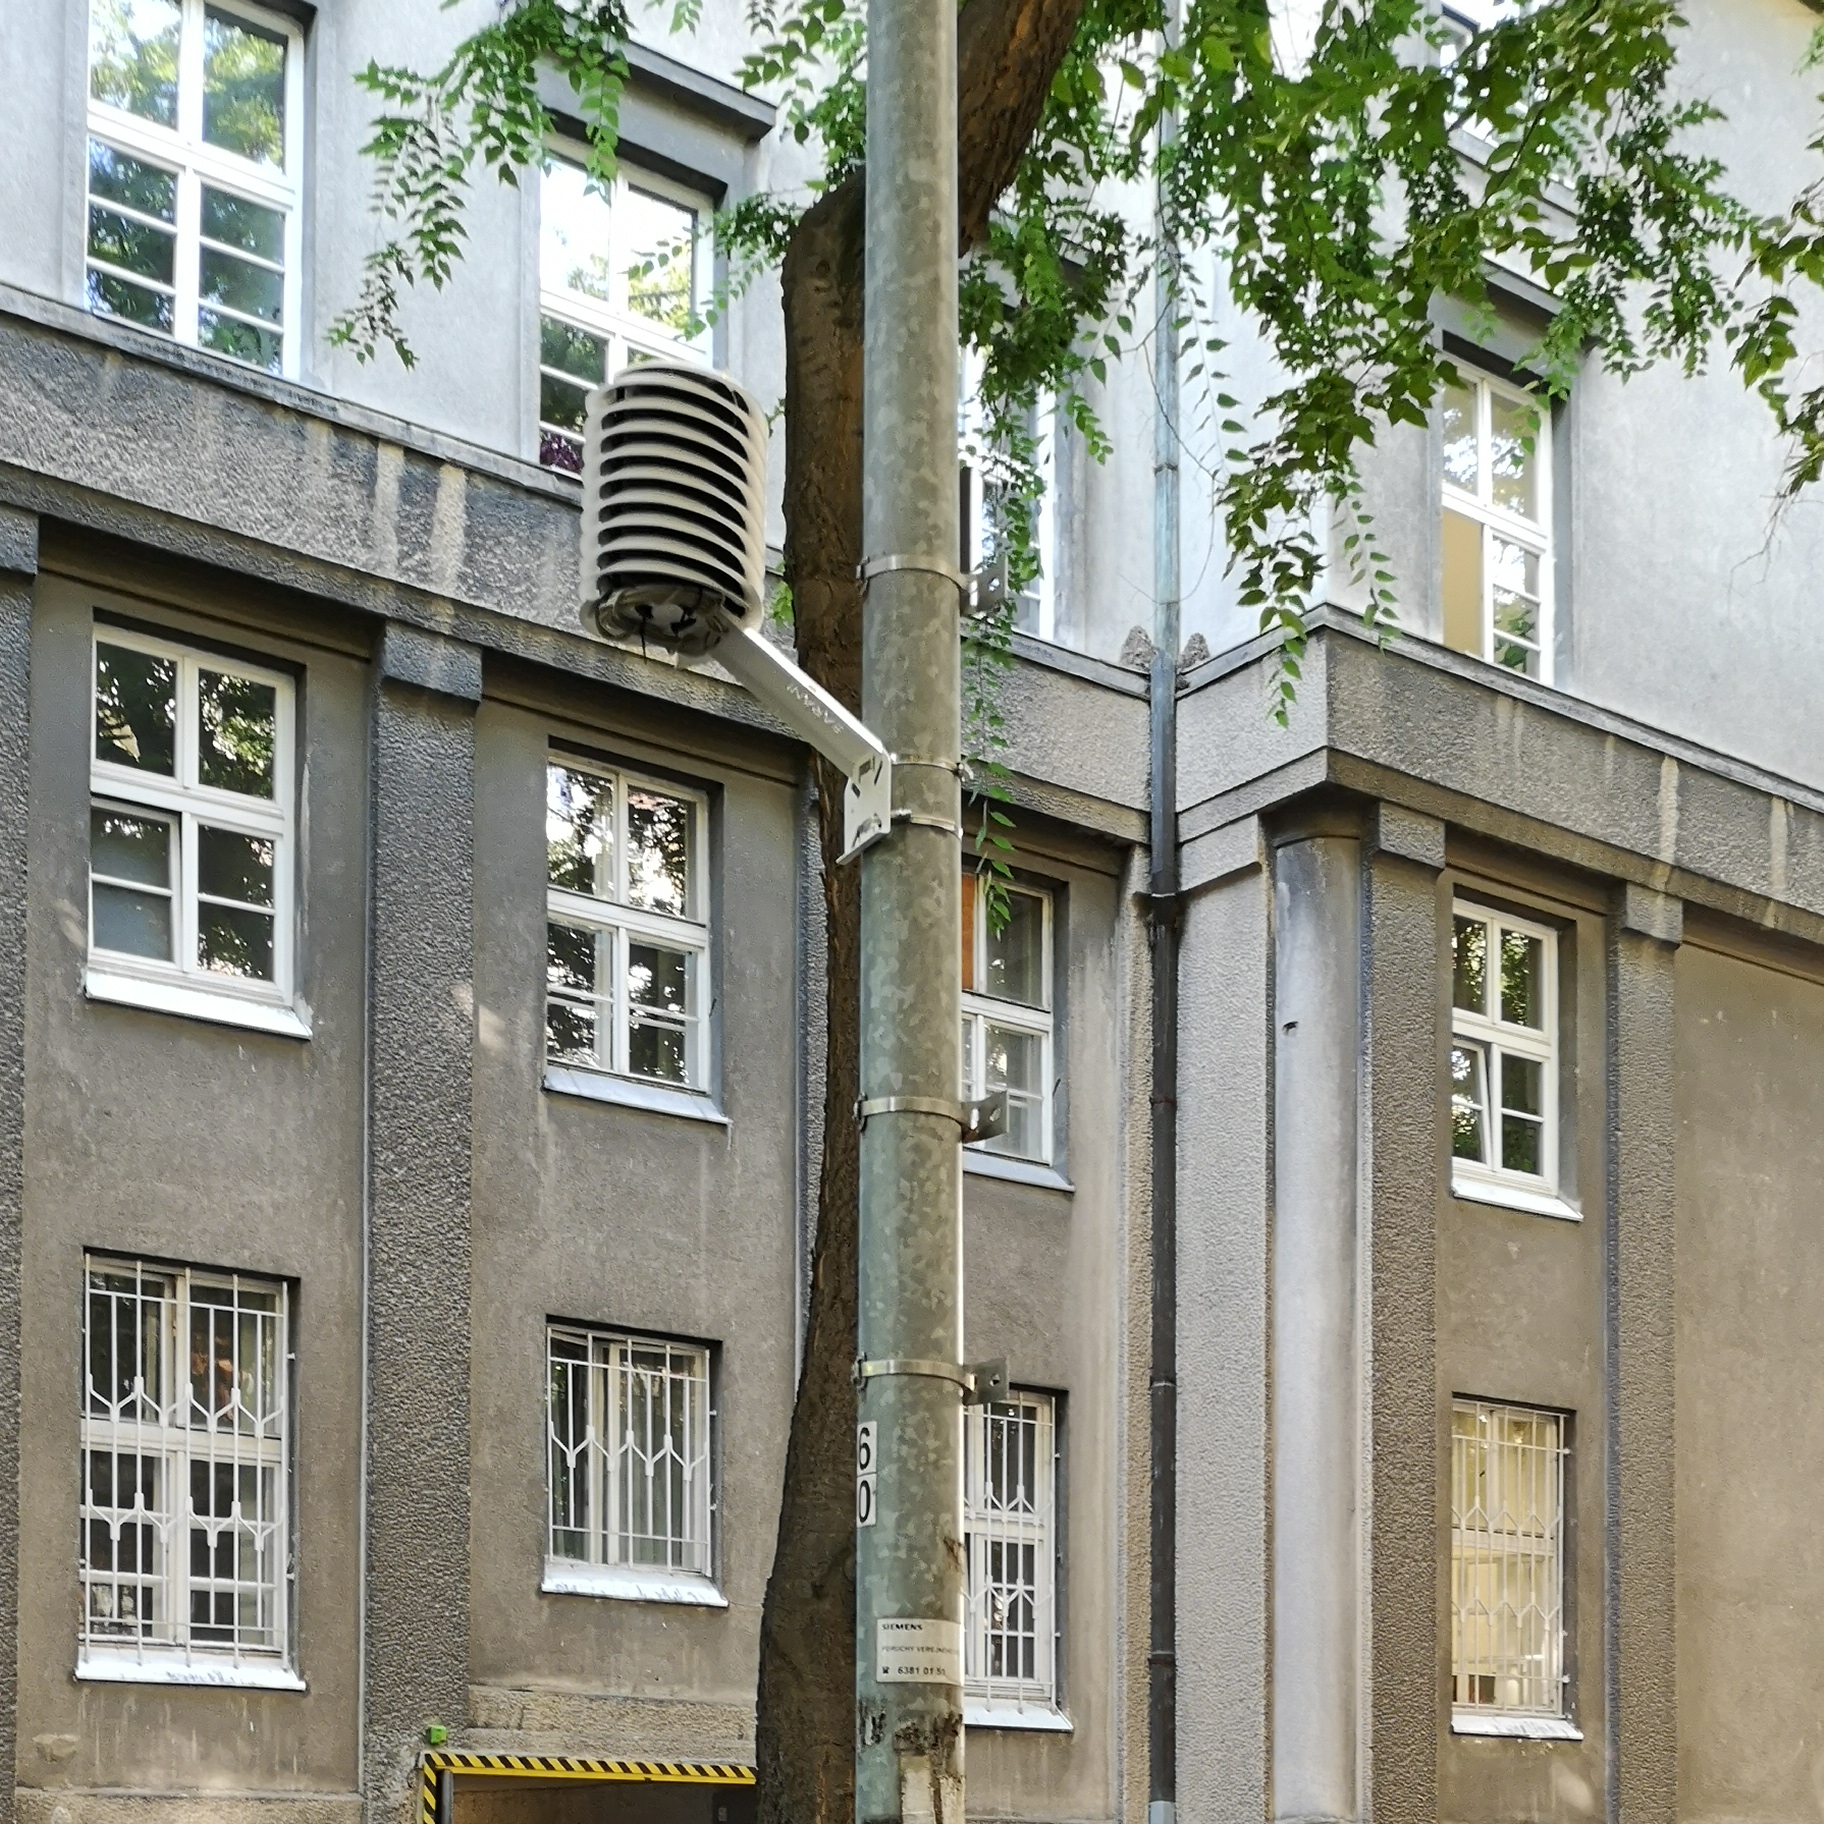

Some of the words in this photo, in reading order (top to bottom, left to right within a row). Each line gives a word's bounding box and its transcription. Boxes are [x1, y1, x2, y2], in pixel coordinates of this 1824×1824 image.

[882, 1623, 923, 1631] SIEMENS
[897, 1666, 920, 1675] 6381
[923, 1667, 934, 1675] 01
